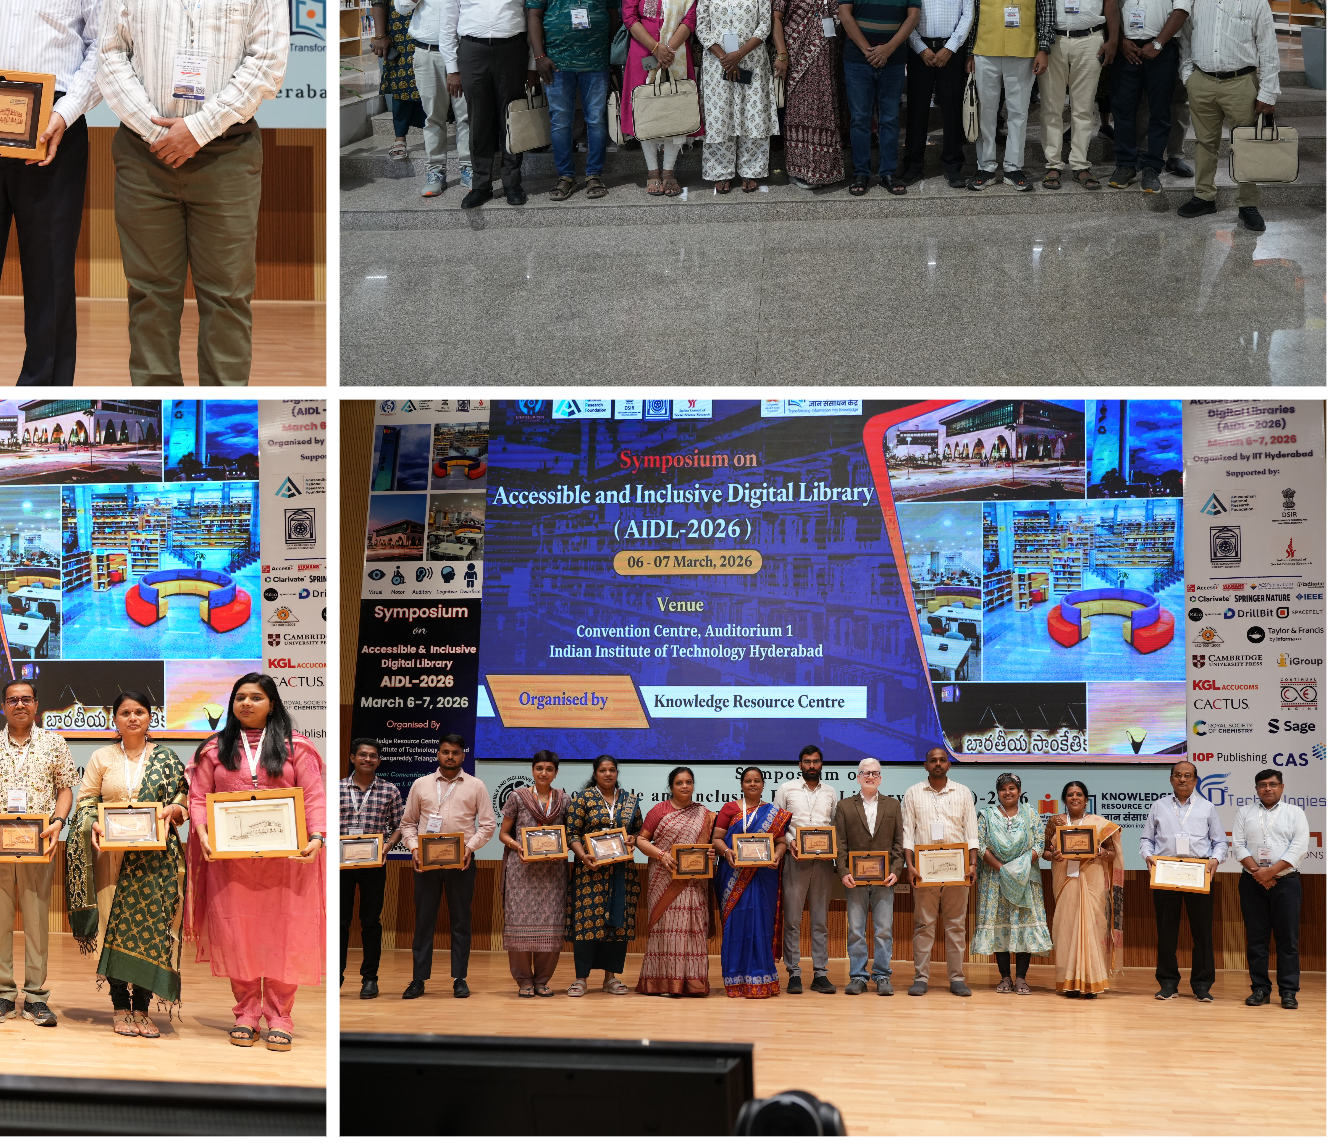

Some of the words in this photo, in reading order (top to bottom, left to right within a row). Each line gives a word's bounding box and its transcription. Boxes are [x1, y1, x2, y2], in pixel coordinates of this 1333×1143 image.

[620, 449, 727, 473] Symposium
[733, 451, 757, 468] on
[1235, 594, 1265, 602] SPRINGER
[1266, 594, 1290, 602] NATURE
[1268, 627, 1289, 635] Taylor
[671, 643, 746, 662] Technology
[749, 643, 823, 662] Hyderabad
[361, 697, 404, 708] March
[436, 697, 468, 708] 2026
[1273, 753, 1308, 767] CAS
